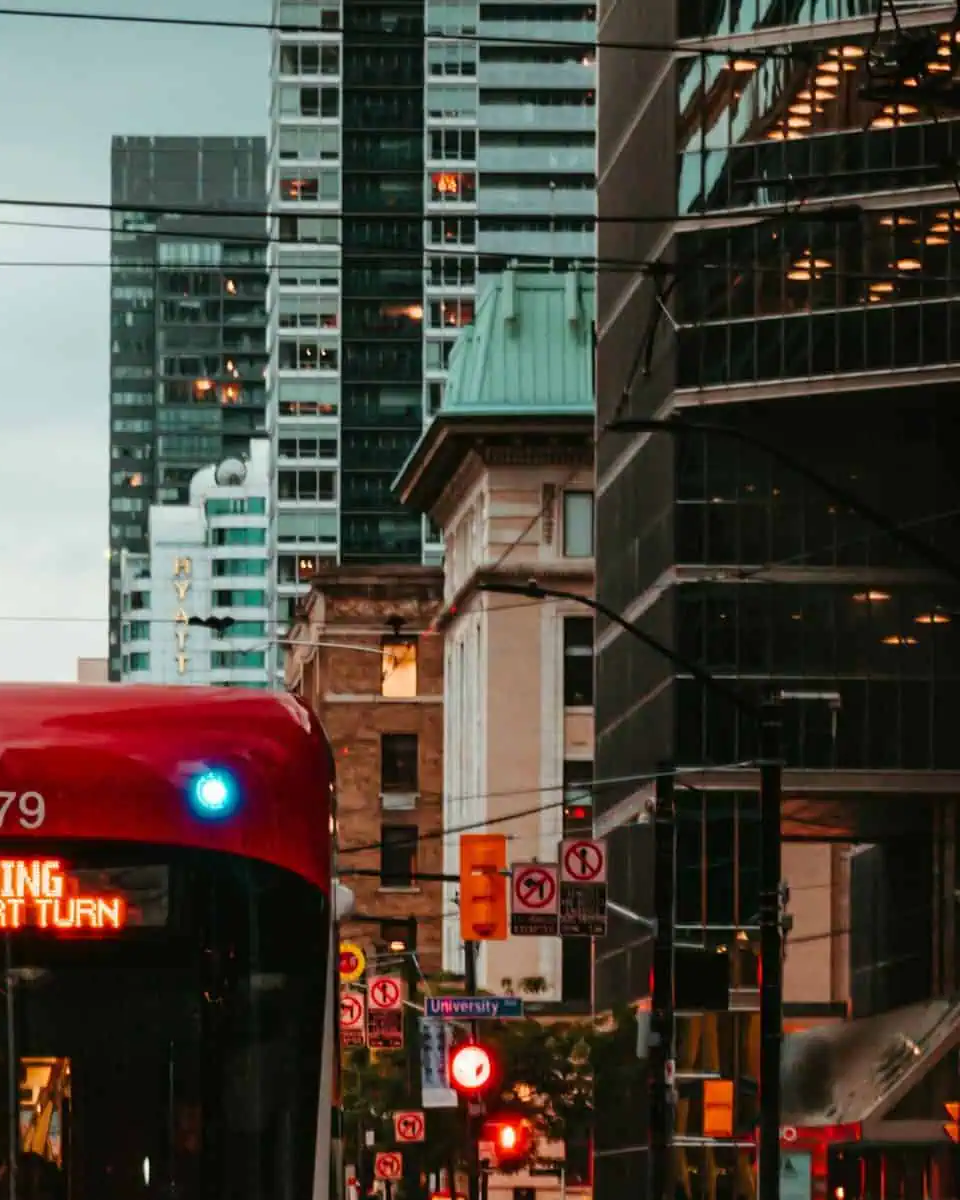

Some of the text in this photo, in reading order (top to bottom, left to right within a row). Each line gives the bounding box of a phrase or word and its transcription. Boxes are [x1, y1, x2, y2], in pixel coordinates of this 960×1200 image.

[174, 558, 191, 673] HYATT
[35, 898, 119, 928] TURN
[431, 999, 499, 1016] University
